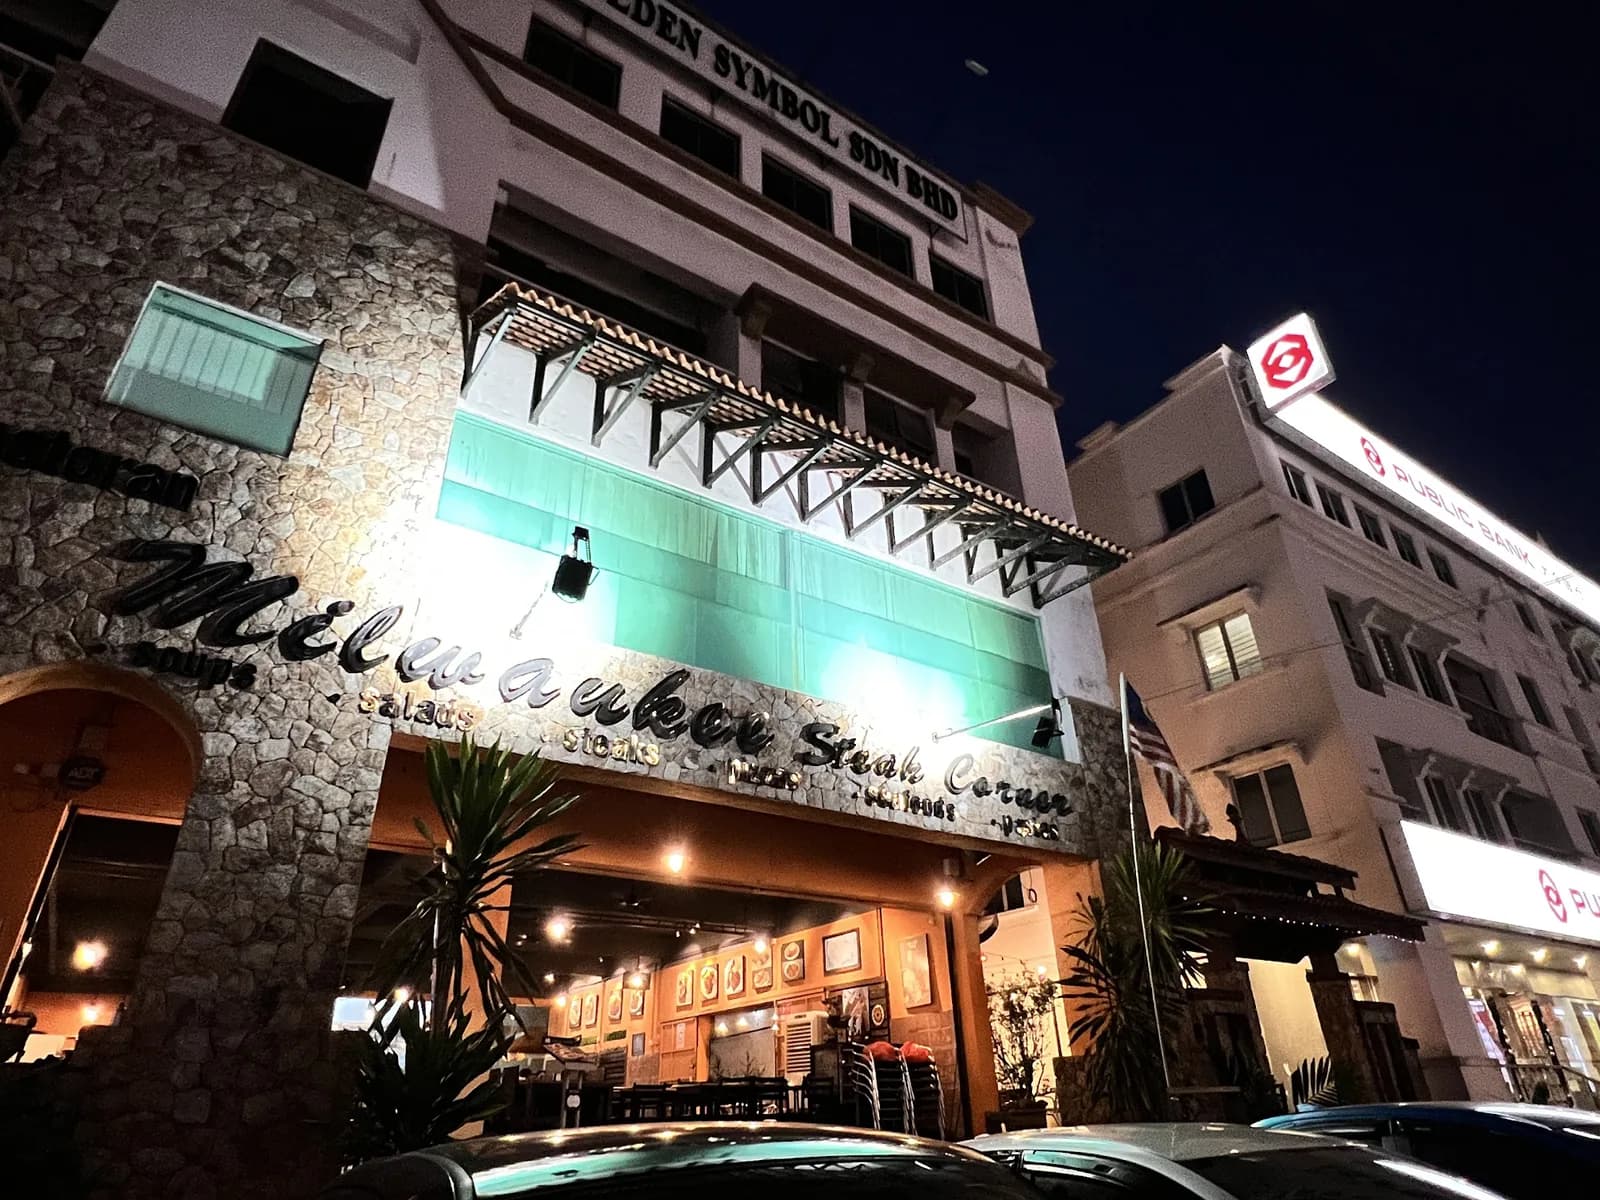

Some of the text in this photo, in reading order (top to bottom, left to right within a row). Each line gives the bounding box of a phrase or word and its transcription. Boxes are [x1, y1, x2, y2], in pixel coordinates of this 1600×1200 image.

[713, 43, 839, 149] SYMBOL
[849, 130, 900, 187] SDN
[904, 164, 958, 222] BHD
[1392, 463, 1535, 569] PUBLIC BANK
[105, 539, 1072, 816] Milwaukee Steak Corner
[1568, 888, 1600, 918] PU
